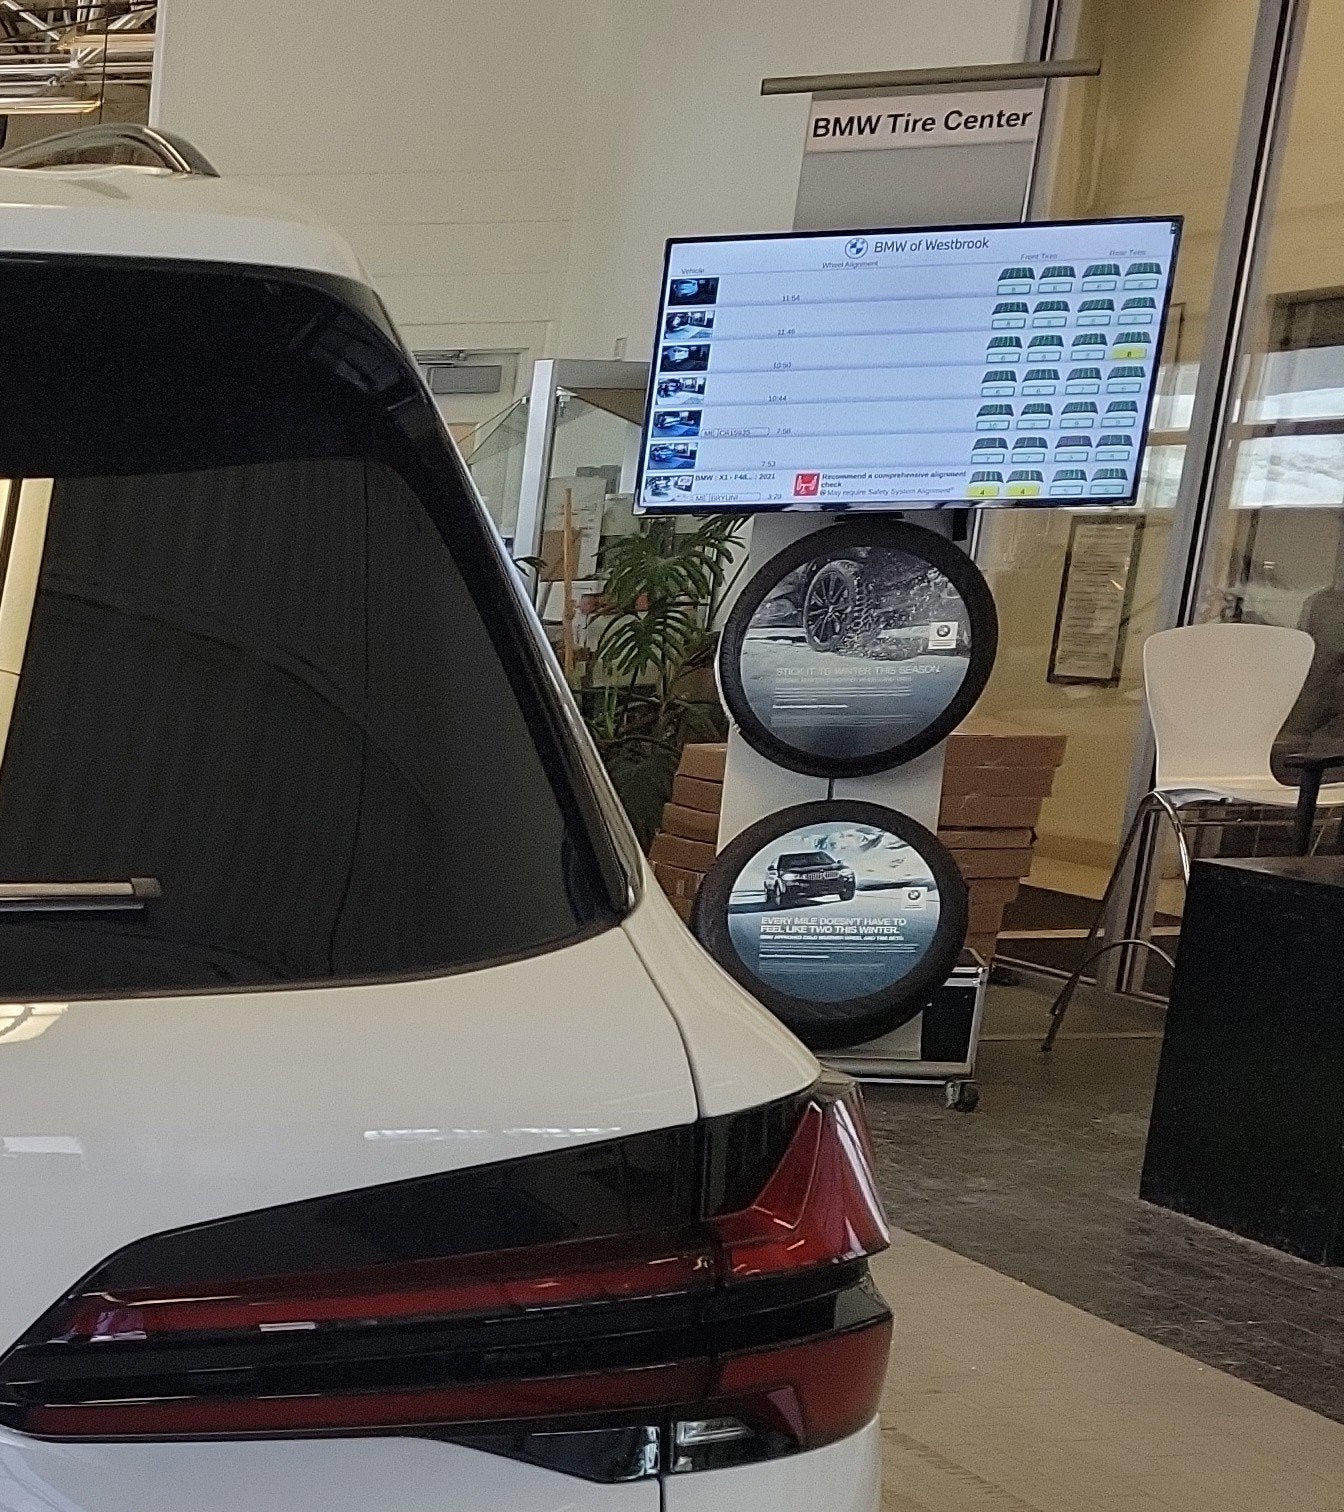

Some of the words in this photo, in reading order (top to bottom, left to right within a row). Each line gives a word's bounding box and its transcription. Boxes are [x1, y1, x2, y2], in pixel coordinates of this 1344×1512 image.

[812, 114, 883, 139] BMW
[887, 112, 937, 134] Tire
[943, 109, 1034, 131] Center
[874, 240, 908, 253] BMW
[910, 239, 924, 251] of
[925, 236, 990, 251] Westbrook
[822, 260, 844, 269] Wheel
[845, 259, 879, 270] Alignment
[822, 472, 867, 480] Recommend
[874, 471, 930, 480] comprehensive
[930, 470, 967, 479] alignment
[842, 488, 867, 497] require
[868, 487, 890, 496] Safety
[891, 487, 916, 496] System
[761, 917, 792, 925] EVERY
[794, 917, 819, 925] MILE
[819, 917, 862, 926] DOESN'T
[864, 918, 891, 926] HAVE
[893, 918, 907, 926] TO
[761, 925, 783, 933] FEEL
[785, 925, 808, 933] LIKE
[810, 925, 833, 933] TWO
[834, 926, 858, 934] THIS
